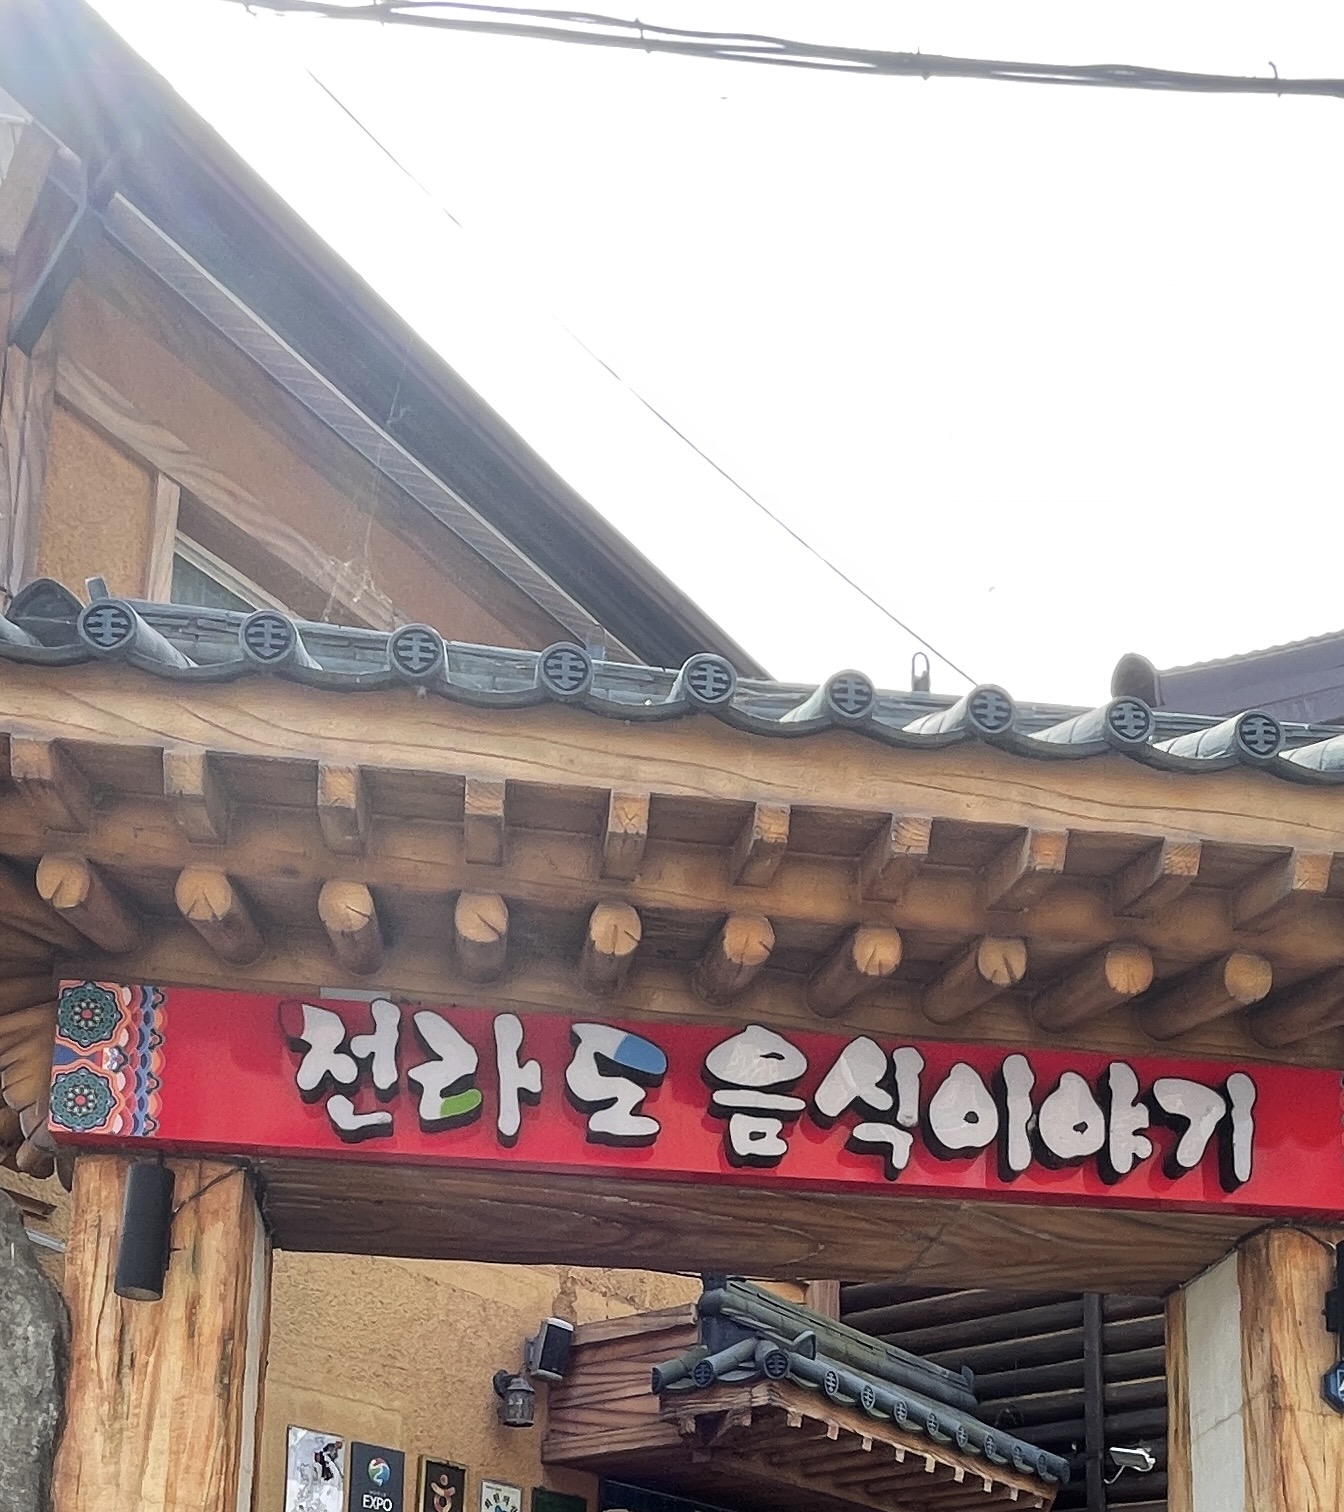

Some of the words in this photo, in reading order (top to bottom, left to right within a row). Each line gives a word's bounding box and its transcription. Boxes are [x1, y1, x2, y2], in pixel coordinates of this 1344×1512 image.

[278, 996, 668, 1148] 전라도
[701, 1023, 1258, 1193] 음식이야기
[362, 1494, 393, 1512] EXPO
